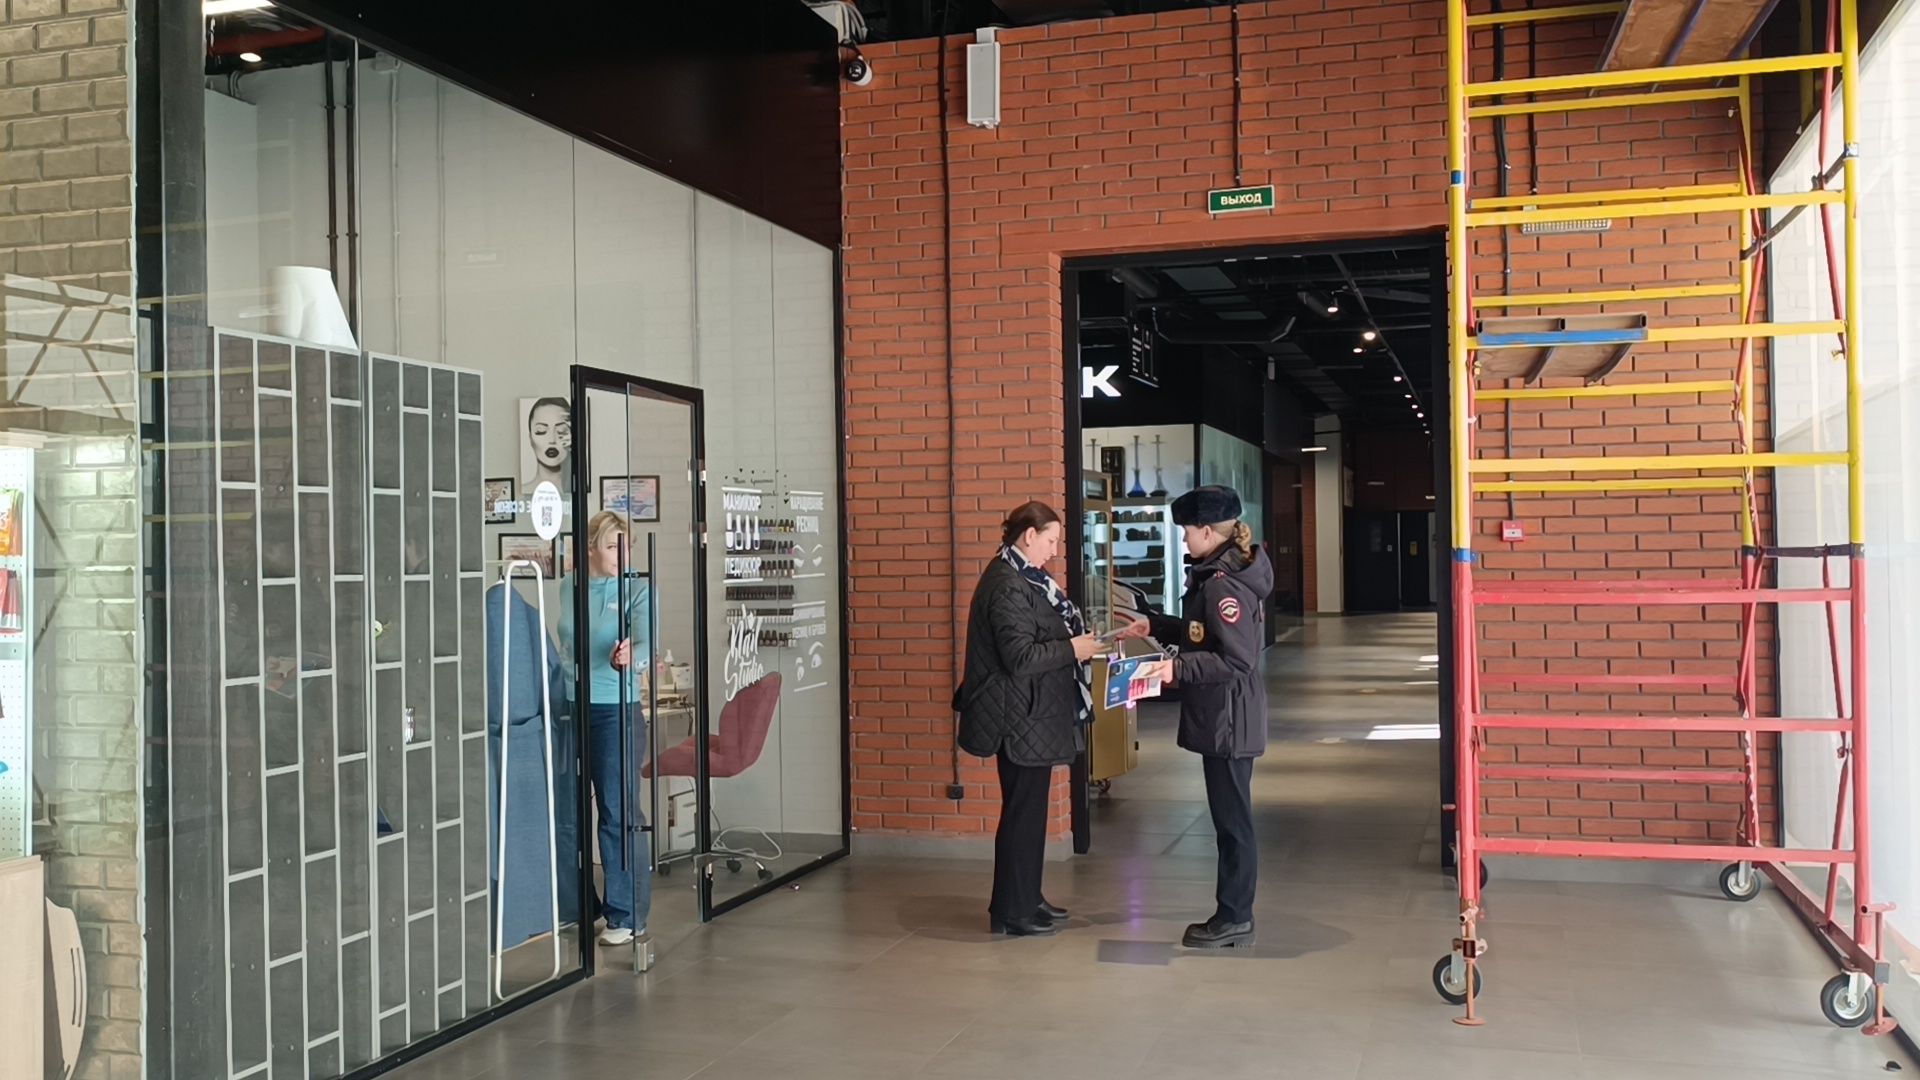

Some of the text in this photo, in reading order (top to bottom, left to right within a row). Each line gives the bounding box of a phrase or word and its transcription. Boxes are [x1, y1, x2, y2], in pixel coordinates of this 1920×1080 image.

[1220, 193, 1263, 206] ВЫХОД
[1082, 365, 1122, 398] К
[723, 493, 762, 512] МАНИКЮР
[725, 556, 762, 577] ПЕДИКЮР
[730, 616, 764, 665] Nail
[724, 650, 765, 702] Studio
